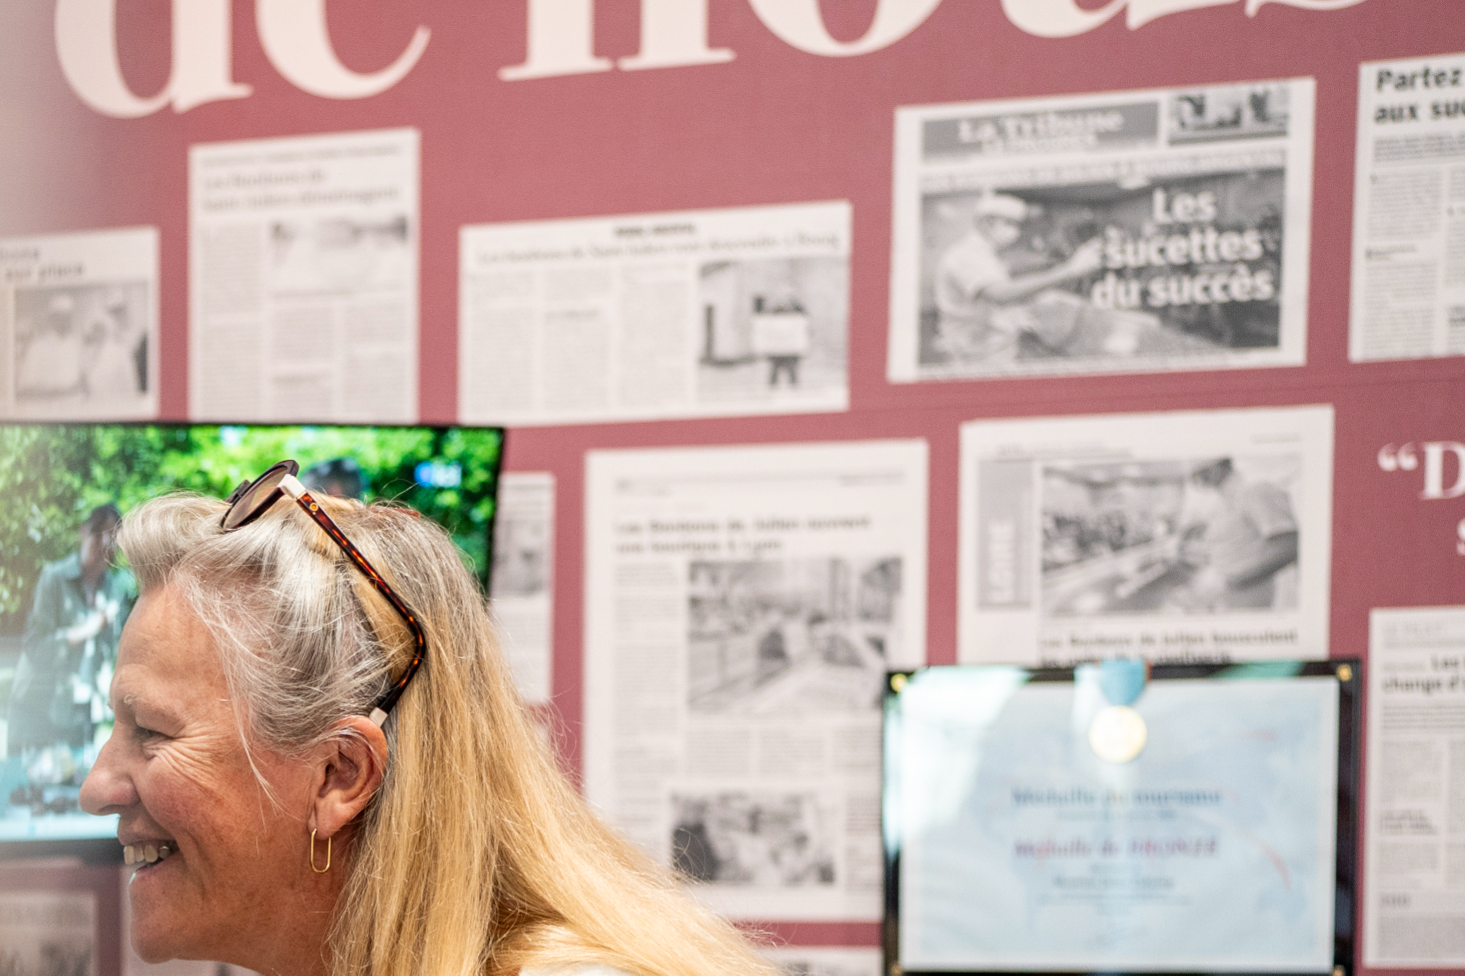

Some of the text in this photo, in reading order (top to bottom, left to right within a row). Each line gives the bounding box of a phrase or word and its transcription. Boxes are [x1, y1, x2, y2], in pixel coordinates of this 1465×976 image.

[1376, 66, 1462, 92] Partez
[1002, 110, 1125, 140] Tribune
[1374, 105, 1418, 124] aux
[1152, 187, 1217, 224] Les
[1104, 227, 1264, 270] sucettes
[1090, 262, 1274, 310] du succès
